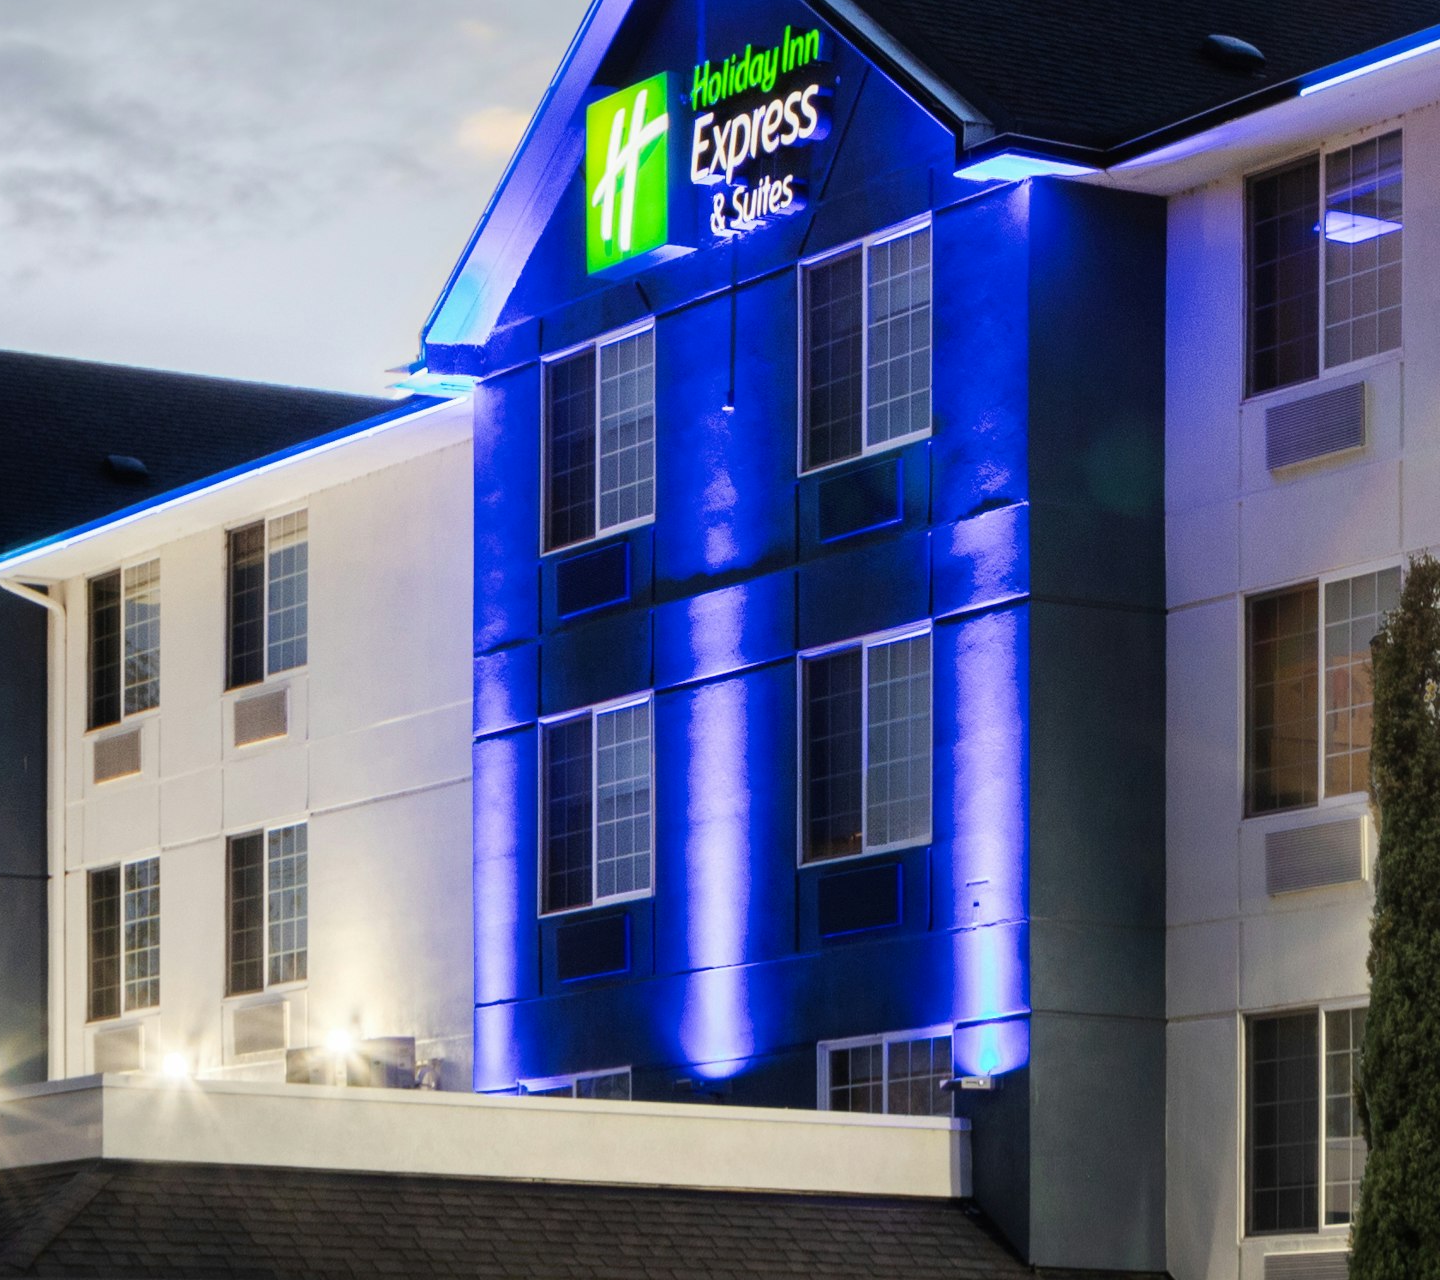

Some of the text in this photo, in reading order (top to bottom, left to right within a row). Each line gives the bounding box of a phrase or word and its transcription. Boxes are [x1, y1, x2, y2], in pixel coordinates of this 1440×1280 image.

[691, 25, 820, 111] Holiday Inn
[690, 84, 820, 184] Express
[710, 174, 794, 234] & Suites
